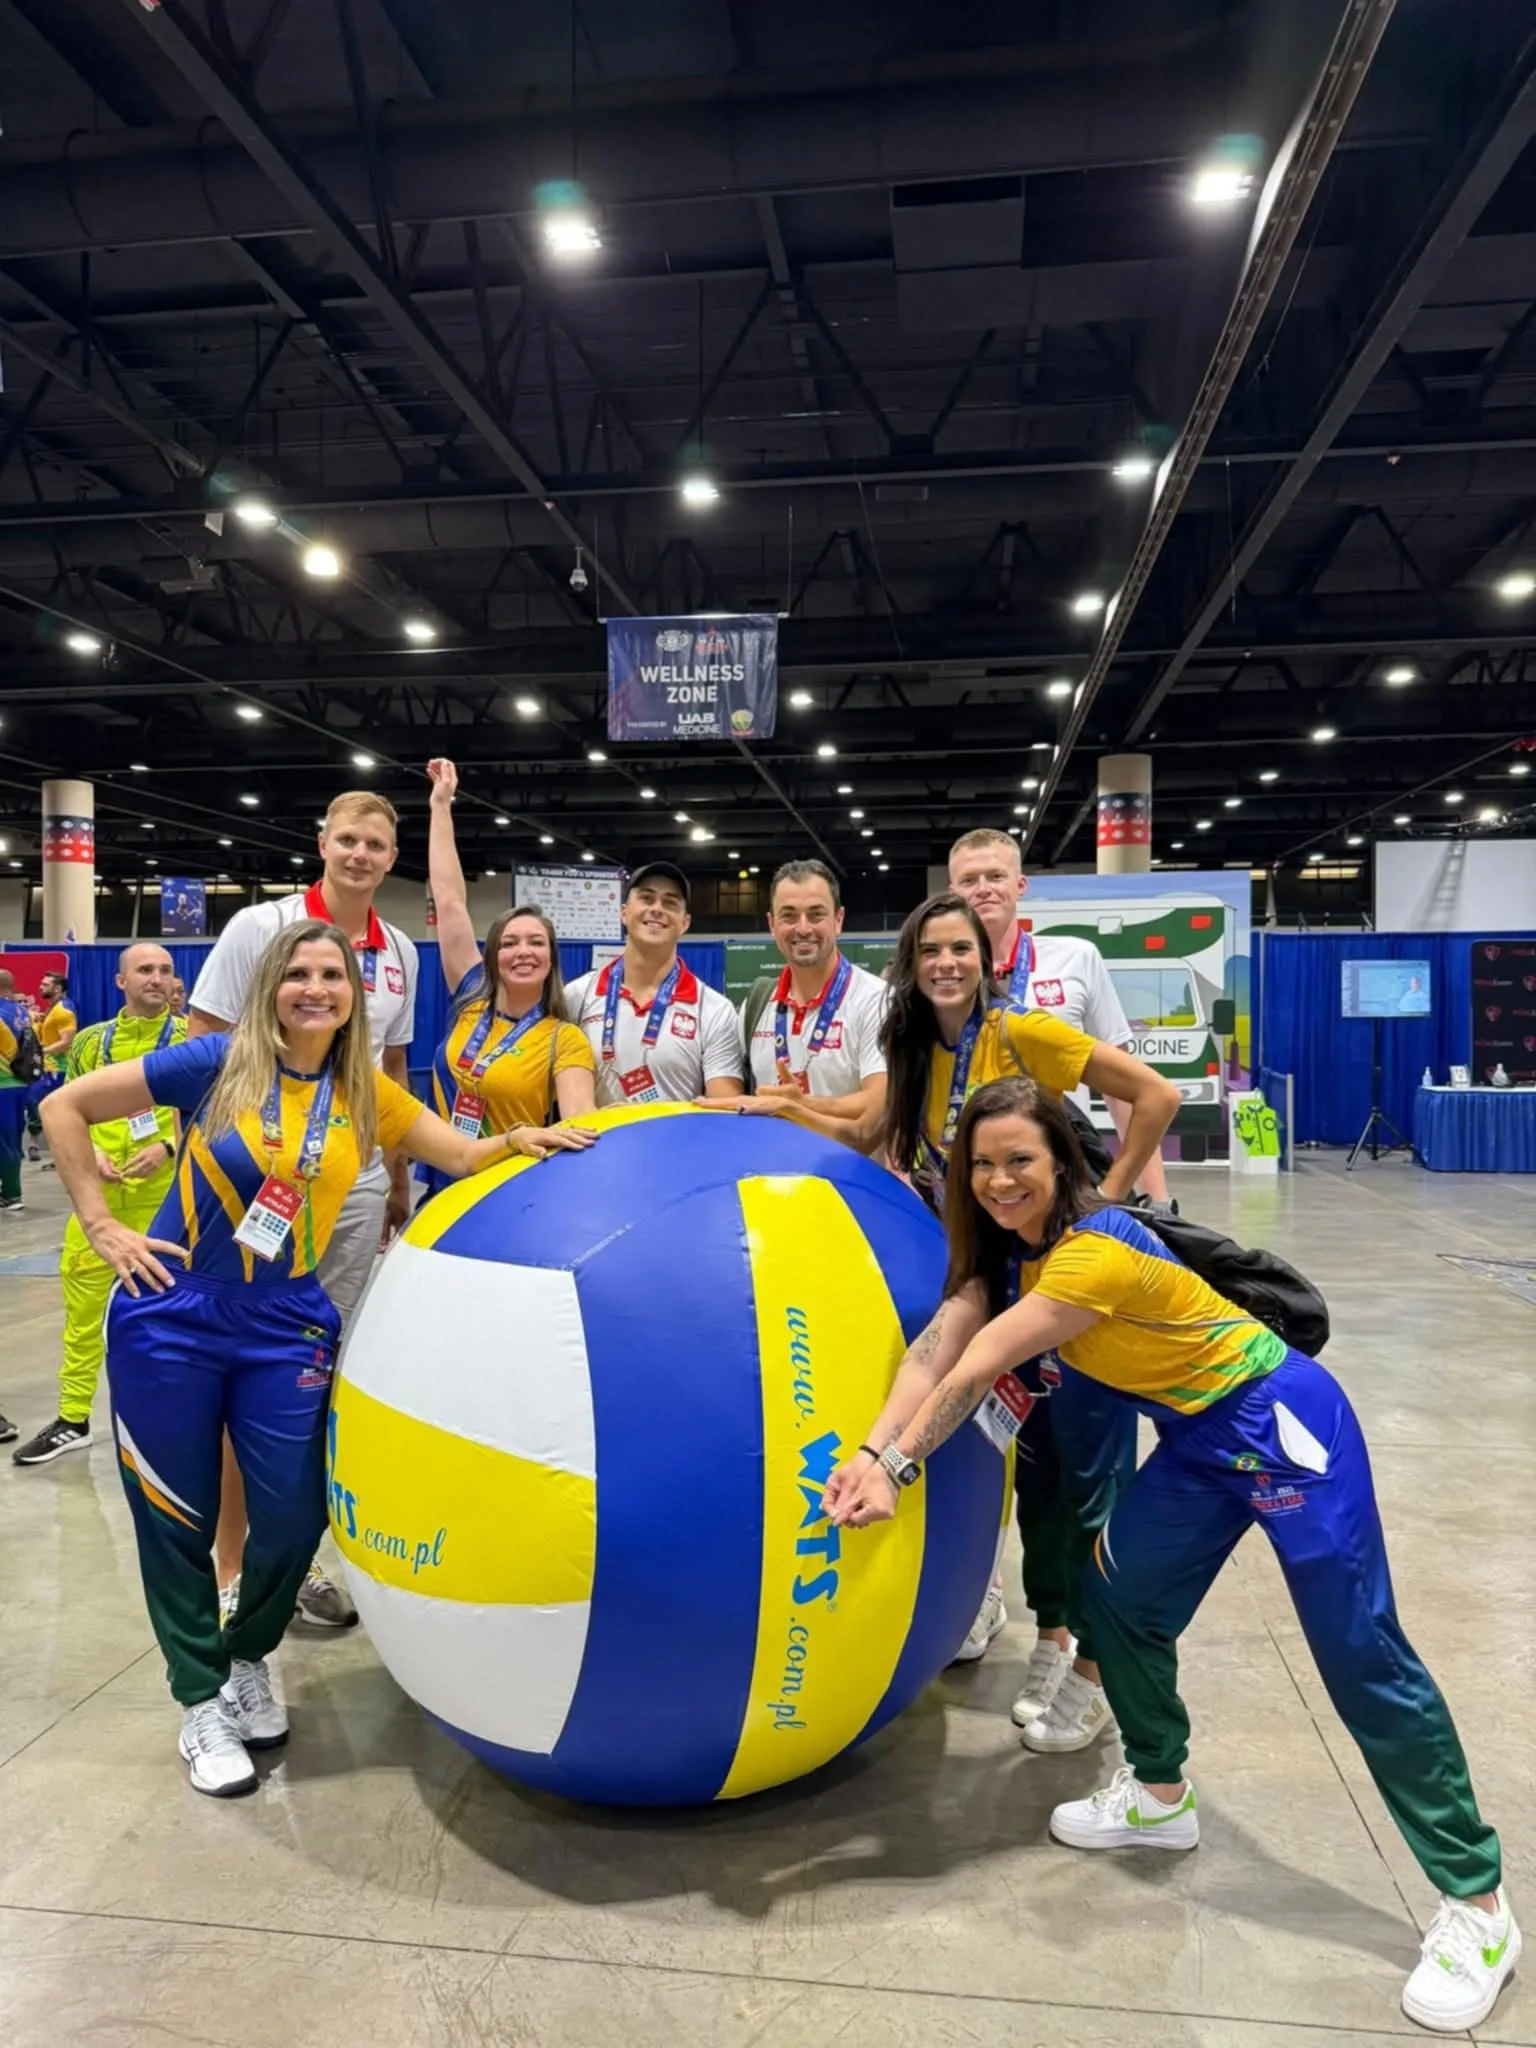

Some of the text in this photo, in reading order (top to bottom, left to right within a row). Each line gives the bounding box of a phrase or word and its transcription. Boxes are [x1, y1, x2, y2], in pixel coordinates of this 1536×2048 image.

[640, 664, 744, 683] WELLNESS
[666, 686, 718, 704] ZONE
[678, 713, 715, 724] UAB
[673, 723, 720, 735] MEDICINE
